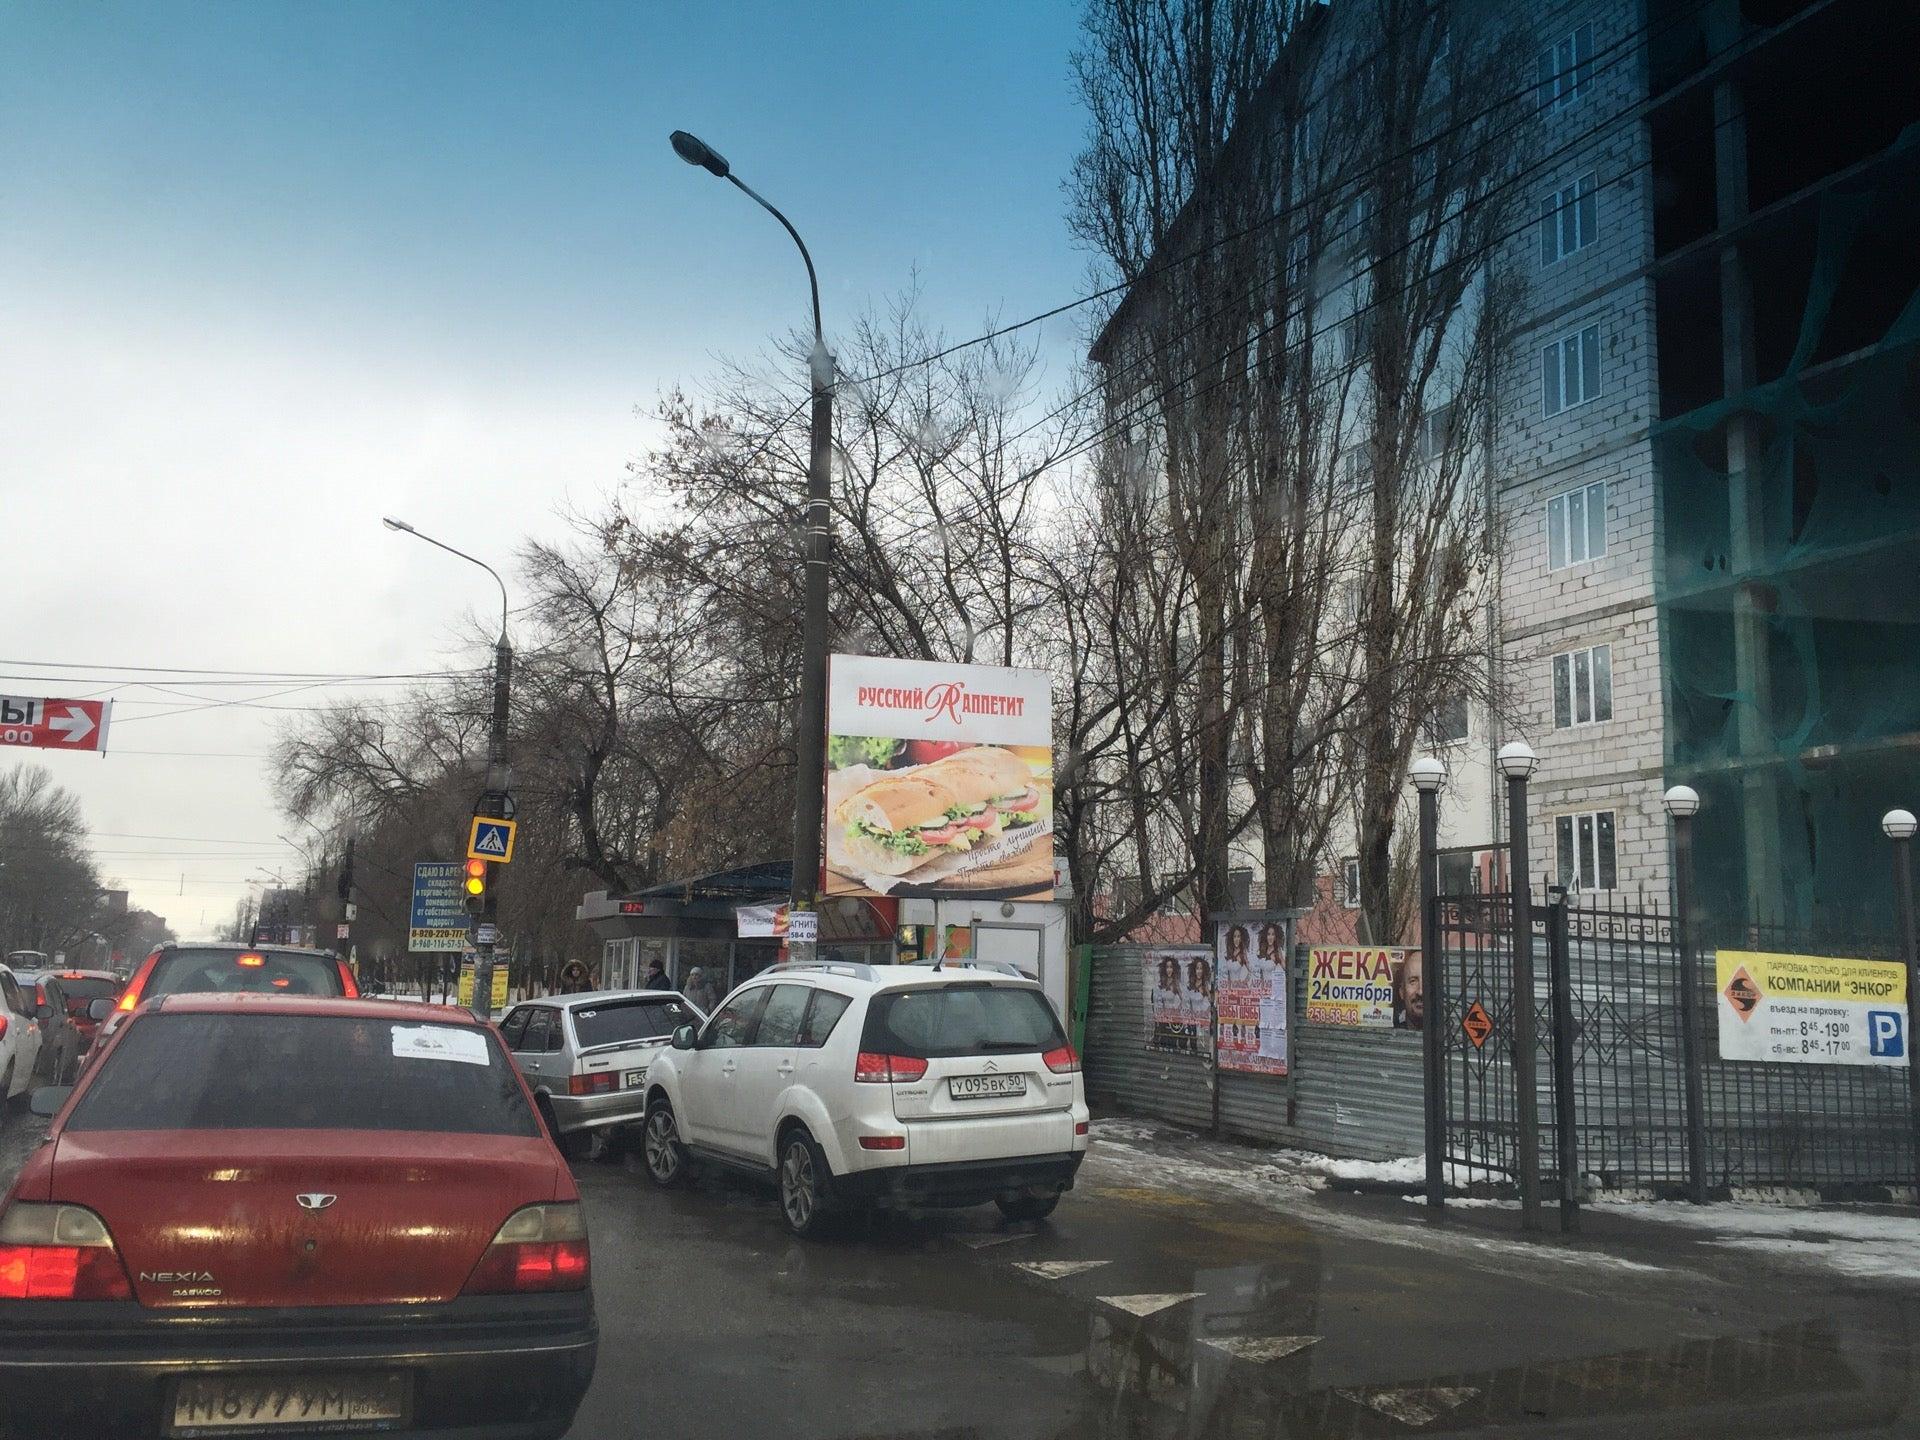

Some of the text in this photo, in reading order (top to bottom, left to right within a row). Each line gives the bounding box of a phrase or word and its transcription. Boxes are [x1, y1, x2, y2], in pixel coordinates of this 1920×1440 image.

[858, 685, 923, 710] РУССКИЙ
[962, 693, 1025, 717] АППЕТИТ
[1, 699, 35, 726] Ы
[445, 866, 461, 877] АРЕ
[1312, 950, 1393, 982] ЖЕКА
[1767, 961, 1899, 980] ПАРКОВКА ТОЛЬКО ДЛЯ КЛИЕНТОВ
[1311, 980, 1330, 1001] 24
[1332, 982, 1392, 1006] октября
[1768, 975, 1841, 994] КОМПАНИИ
[1307, 1006, 1359, 1025] 258-58-48
[1770, 1005, 1850, 1018] въезд на парковку:
[1875, 1014, 1898, 1053] P
[1008, 1074, 1021, 1086] 50
[140, 1271, 216, 1282] NEXIA
[172, 1288, 222, 1297] DAEWOO
